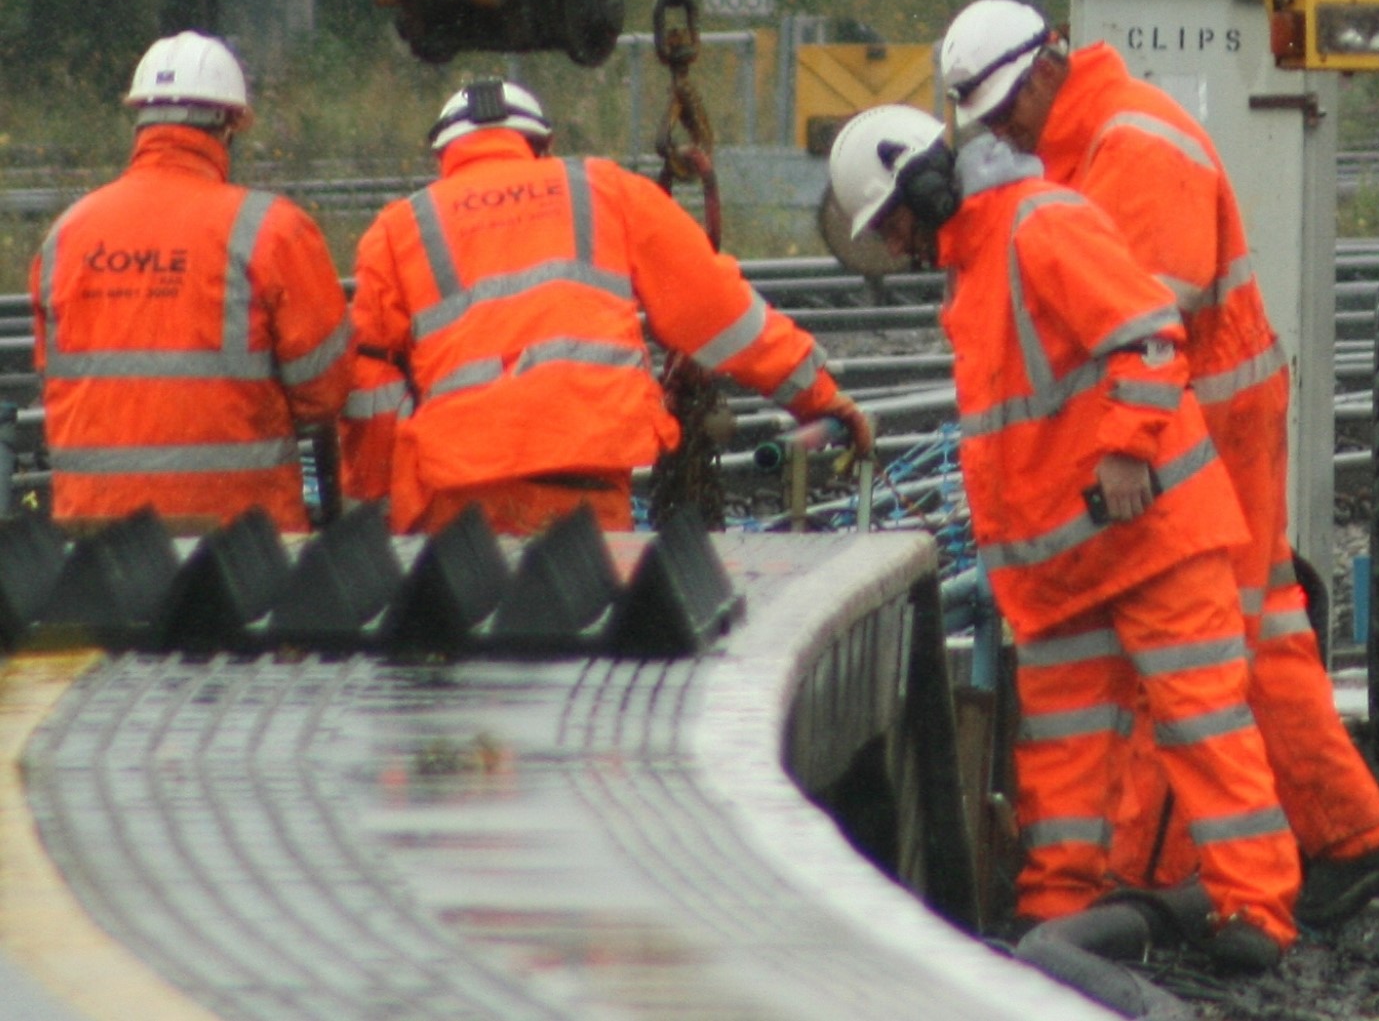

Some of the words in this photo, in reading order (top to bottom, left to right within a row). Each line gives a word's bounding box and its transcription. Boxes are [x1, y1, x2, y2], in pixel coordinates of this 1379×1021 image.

[1128, 27, 1241, 51] CLIPS
[462, 179, 562, 210] COYLE
[87, 240, 187, 273] COYLE
